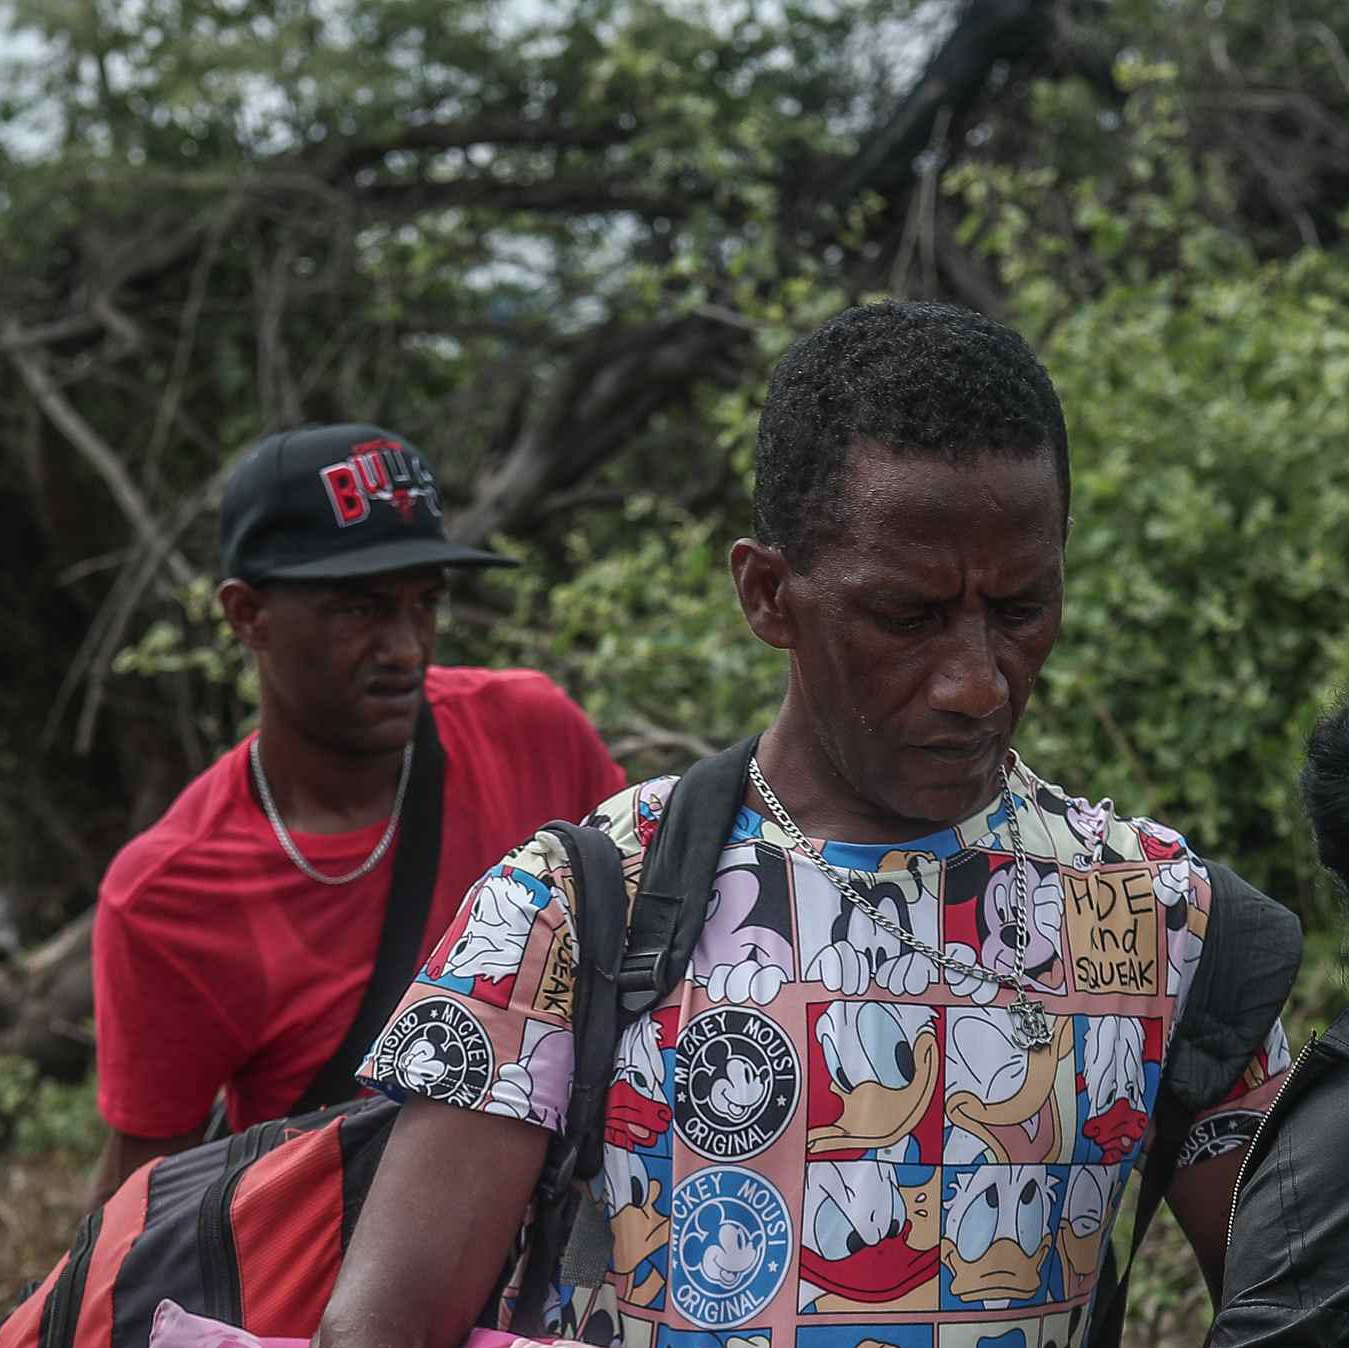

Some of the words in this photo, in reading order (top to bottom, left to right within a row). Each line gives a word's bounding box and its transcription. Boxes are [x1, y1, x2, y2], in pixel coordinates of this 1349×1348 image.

[1069, 873, 1153, 921] HDE
[1076, 957, 1154, 991] SQUEAK
[378, 1011, 419, 1080] ORIGINA
[441, 1004, 487, 1076] MICKEY
[674, 1012, 727, 1085] MICKEY
[685, 1117, 774, 1155] ORIGINAL
[677, 1284, 765, 1322] ORIGINAL
